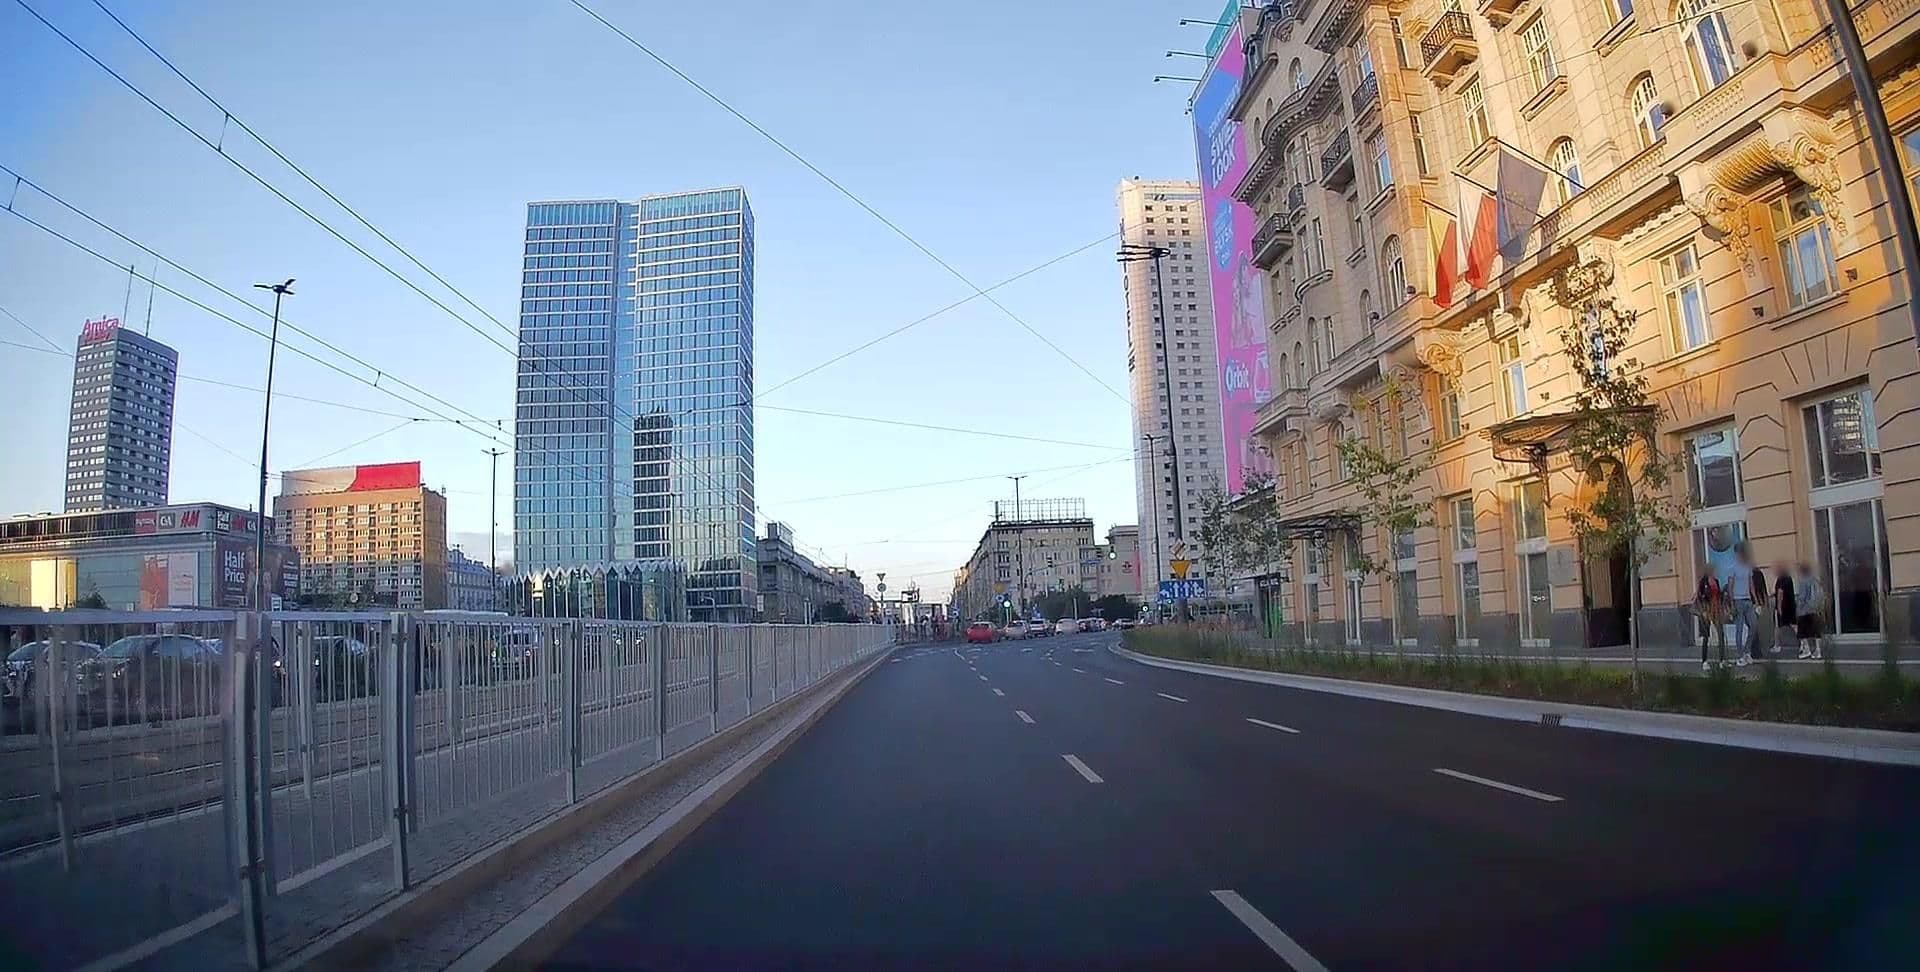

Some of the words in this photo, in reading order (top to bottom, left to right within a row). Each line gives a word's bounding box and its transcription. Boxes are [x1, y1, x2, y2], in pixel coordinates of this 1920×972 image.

[1212, 138, 1236, 189] LOOK
[82, 314, 119, 337] Amica
[1225, 362, 1249, 392] Orbit
[180, 509, 200, 528] H&M
[224, 550, 245, 569] Half
[224, 567, 246, 584] Price
